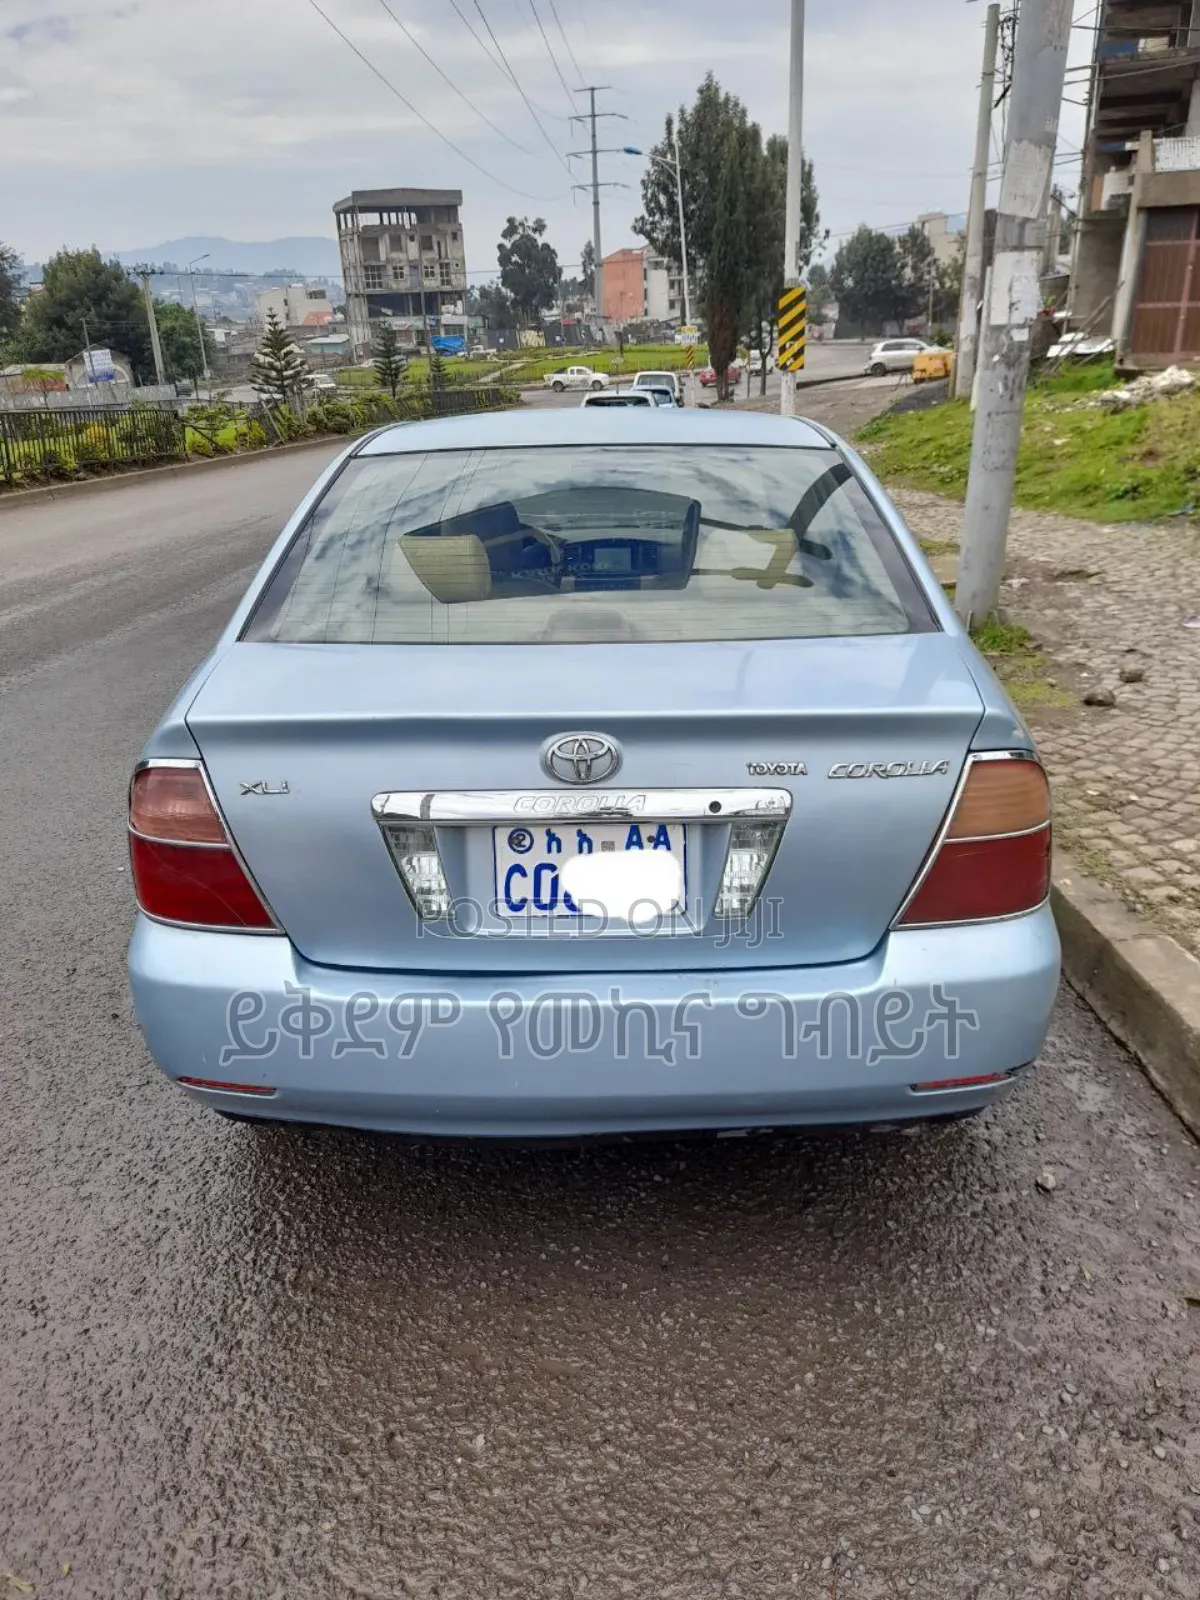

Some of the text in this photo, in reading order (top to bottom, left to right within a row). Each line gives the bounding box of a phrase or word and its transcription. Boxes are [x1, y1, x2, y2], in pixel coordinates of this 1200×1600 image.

[747, 759, 949, 779] TOYOTA COROLLA
[514, 794, 646, 813] COROLLA
